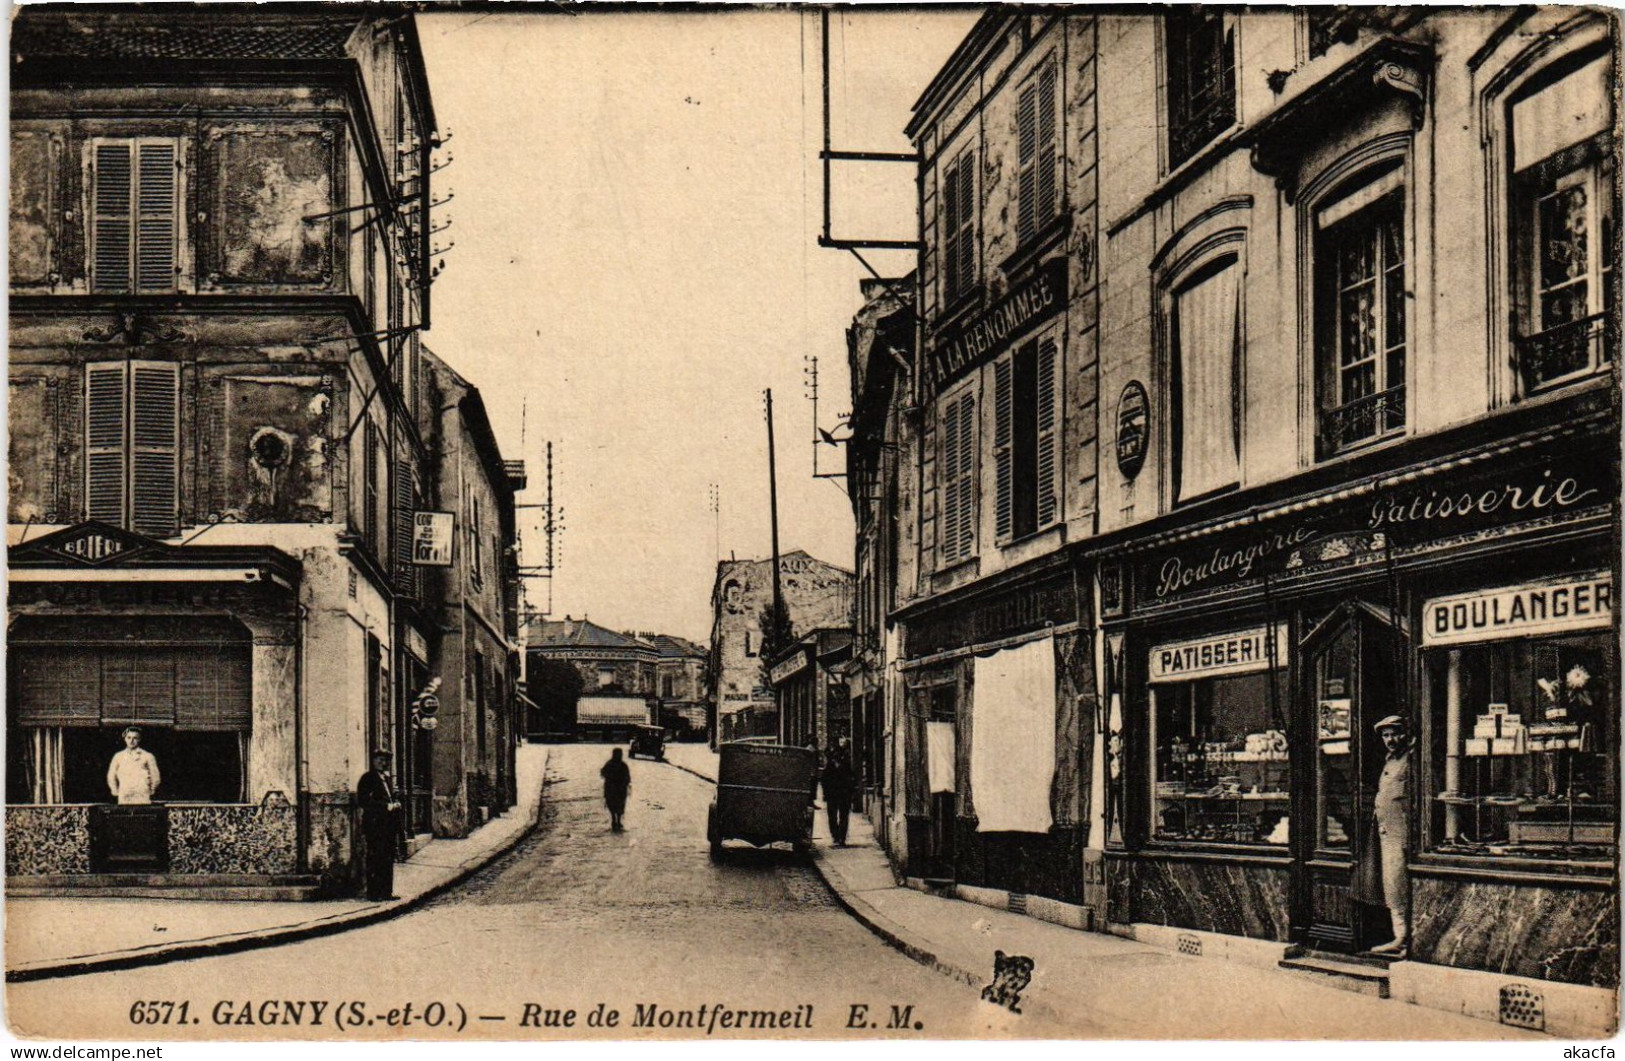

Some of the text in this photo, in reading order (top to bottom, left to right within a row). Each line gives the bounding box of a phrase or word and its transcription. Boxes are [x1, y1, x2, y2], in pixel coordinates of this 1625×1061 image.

[936, 356, 947, 382] A
[947, 340, 966, 374] LA
[1368, 470, 1598, 529] Patisserie
[1434, 582, 1612, 634] BOULANGER
